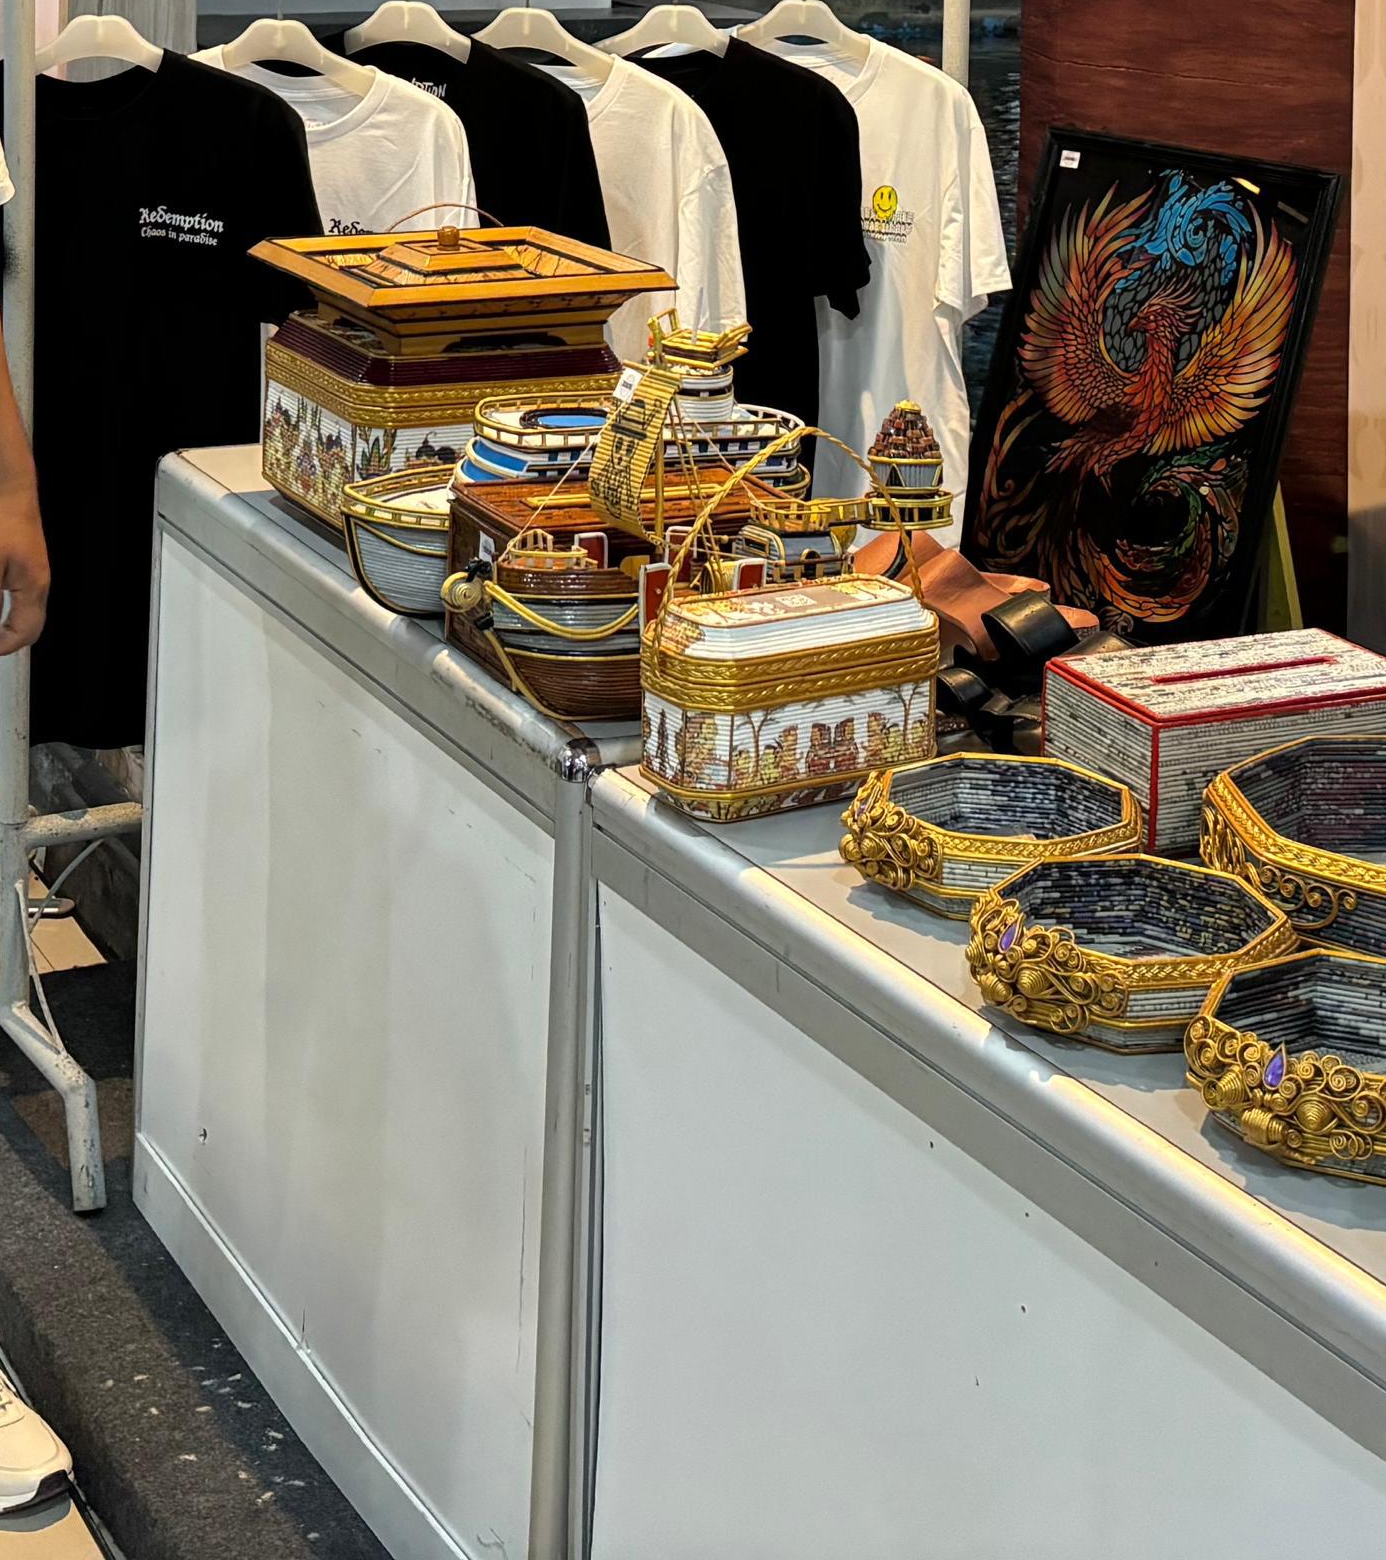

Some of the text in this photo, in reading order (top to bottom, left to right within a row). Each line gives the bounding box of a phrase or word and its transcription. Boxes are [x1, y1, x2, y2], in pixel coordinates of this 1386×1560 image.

[139, 205, 224, 233] Redemption
[140, 226, 218, 246] Chaos in paradise
